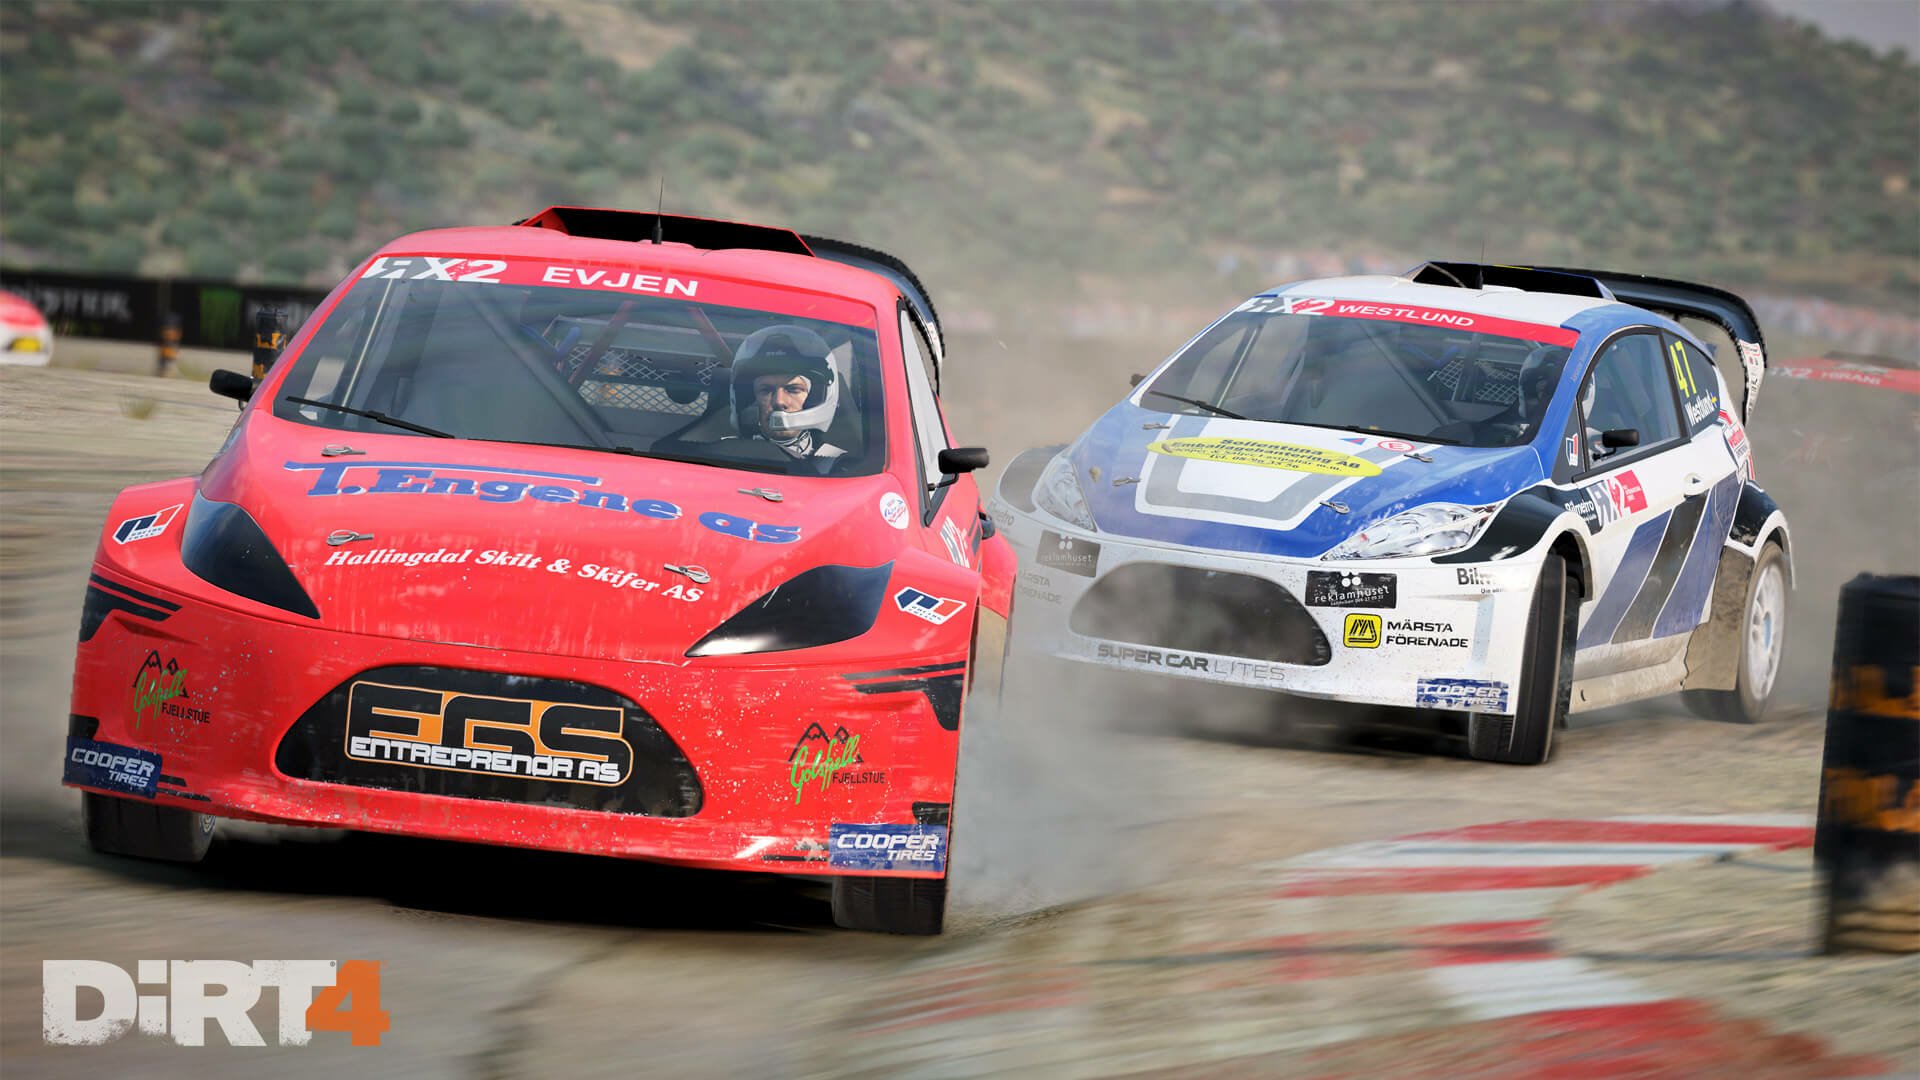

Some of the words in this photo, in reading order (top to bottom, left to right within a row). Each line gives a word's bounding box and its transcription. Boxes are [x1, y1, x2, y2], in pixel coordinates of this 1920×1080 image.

[542, 266, 698, 297] EVJEN
[1338, 305, 1474, 327] WESTLUND
[1669, 340, 1697, 398] 47
[283, 460, 682, 521] T.Engene
[698, 511, 803, 544] as
[323, 548, 473, 568] Hallingdal
[474, 548, 544, 570] Skilt
[546, 558, 570, 574] &
[576, 562, 663, 593] Skifer
[661, 584, 704, 603] AS
[1314, 585, 1390, 604] reklamhuset
[1387, 619, 1453, 633] MÄRSTA
[1386, 633, 1469, 648] FÖRENADE
[1097, 643, 1162, 666] SUPER
[1165, 654, 1209, 672] CAR
[1214, 659, 1286, 681] LITES
[1424, 684, 1502, 698] COOPER
[161, 703, 211, 724] FJELLSTUE
[71, 748, 156, 778] COOPER
[578, 761, 621, 783] AS
[108, 769, 151, 788] TIRES
[831, 772, 886, 785] FJELLSTUE
[837, 833, 939, 850] COOPER
[886, 850, 937, 861] TIRES
